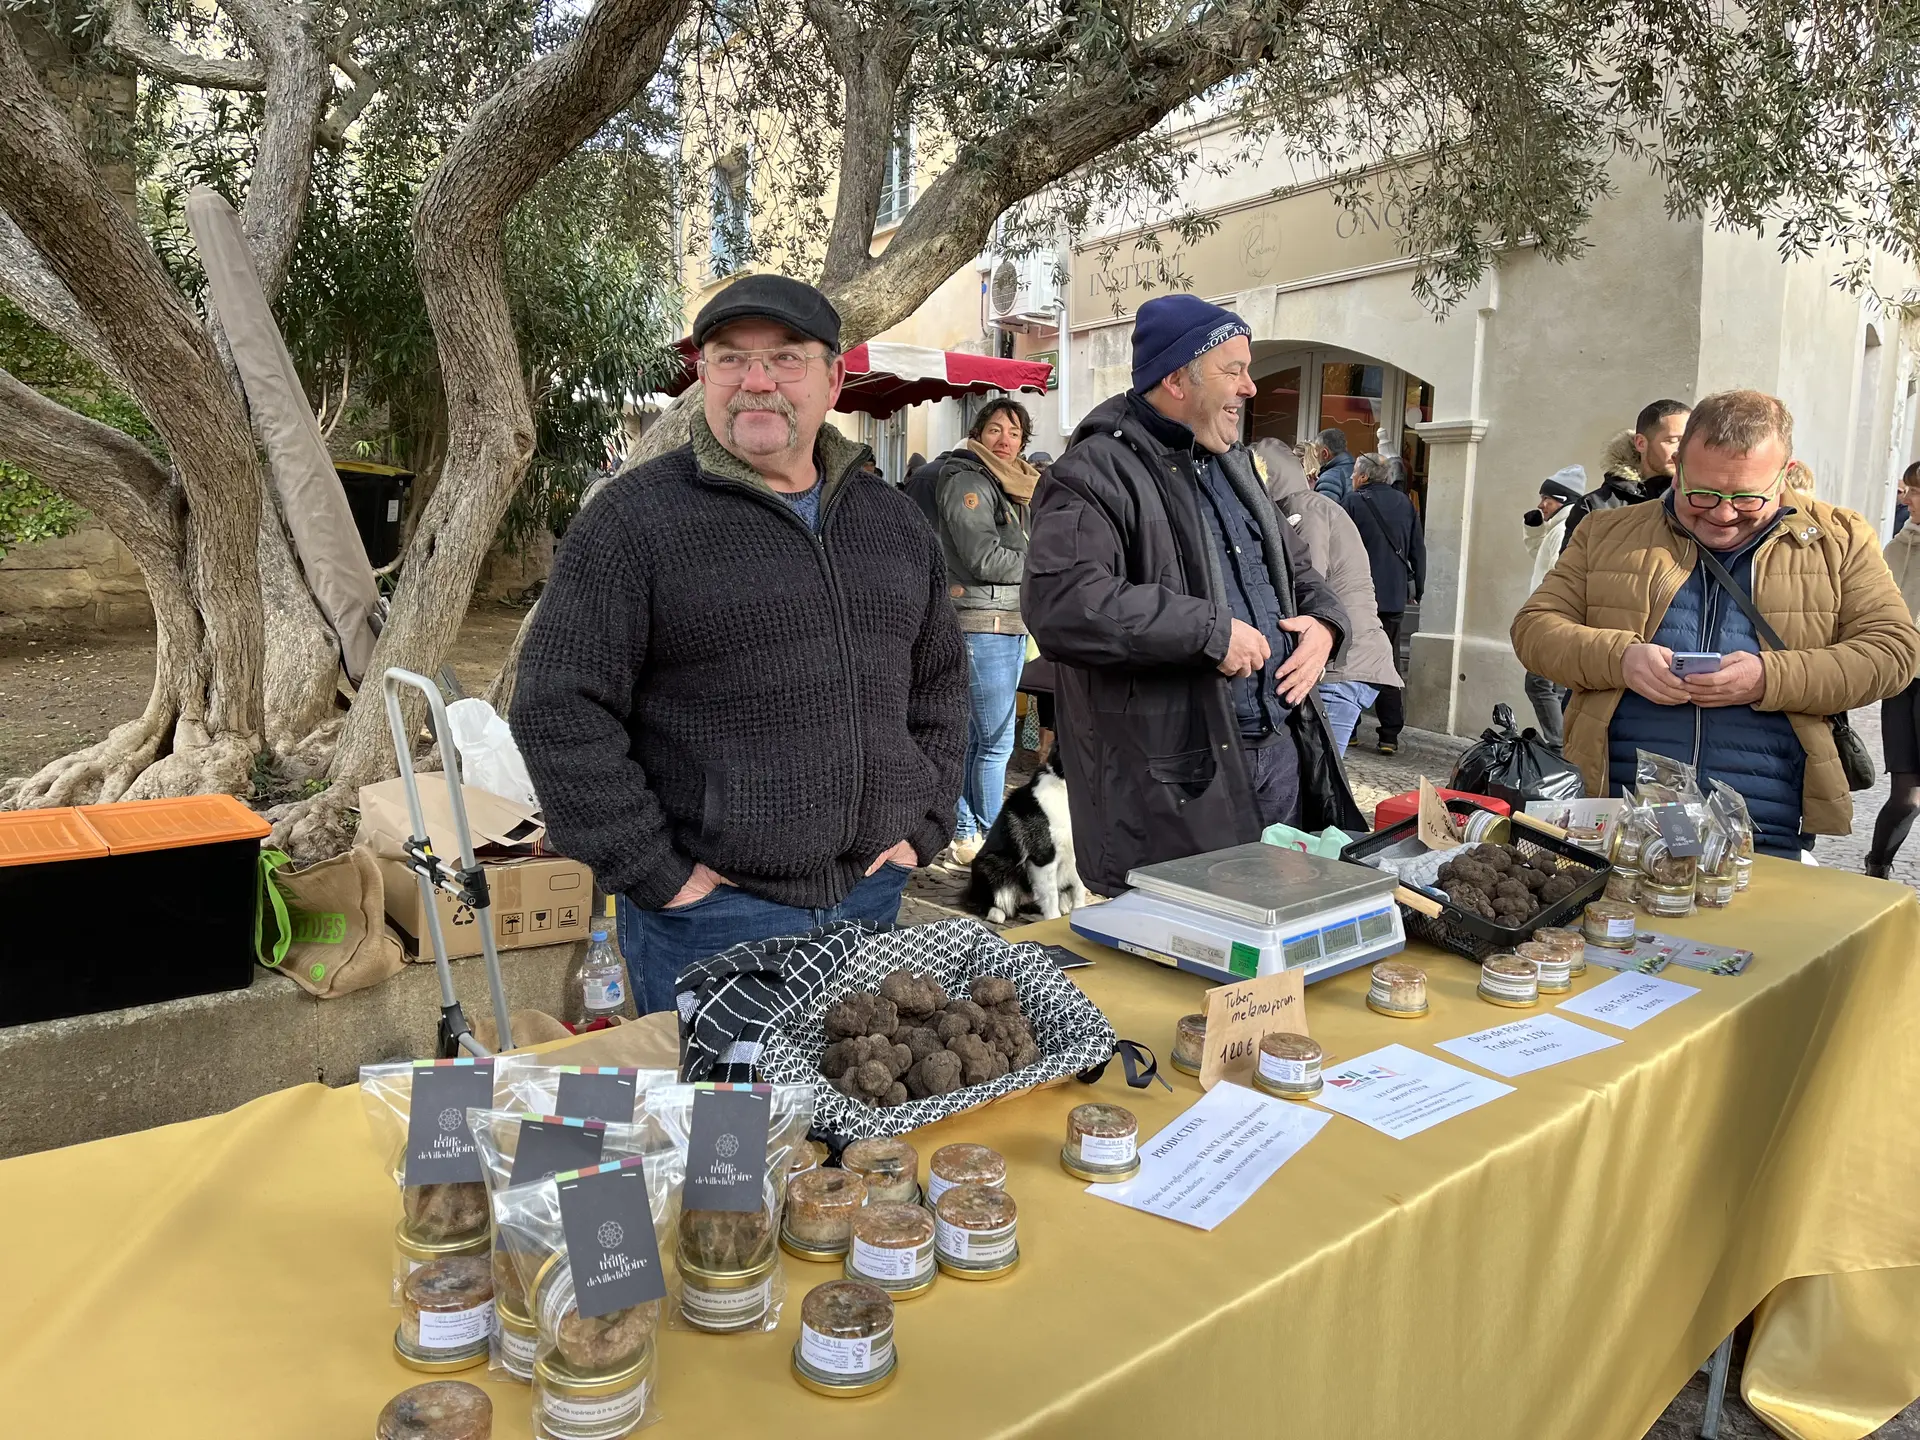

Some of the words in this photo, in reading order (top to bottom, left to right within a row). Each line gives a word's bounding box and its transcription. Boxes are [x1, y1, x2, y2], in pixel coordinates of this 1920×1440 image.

[1090, 252, 1186, 297] INSTITUT
[1194, 326, 1252, 358] SCOTLAND
[564, 909, 573, 919] 4
[1224, 988, 1254, 1010] Tuber
[1467, 1031, 1492, 1043] Duo
[1491, 1029, 1507, 1038] de
[1483, 1038, 1522, 1052] Truffés
[1220, 1040, 1243, 1064] 120
[1246, 1037, 1253, 1056] €
[1518, 1049, 1535, 1057] 15
[1533, 1041, 1562, 1053] euros.
[1151, 1116, 1207, 1159] PRODUCTEUR
[1231, 1120, 1269, 1149] MANOSQUE
[1197, 1138, 1222, 1160] FRANCE
[1208, 1178, 1227, 1196] TUBER
[701, 1297, 723, 1305] supérieur
[570, 1408, 596, 1416] supérieur
